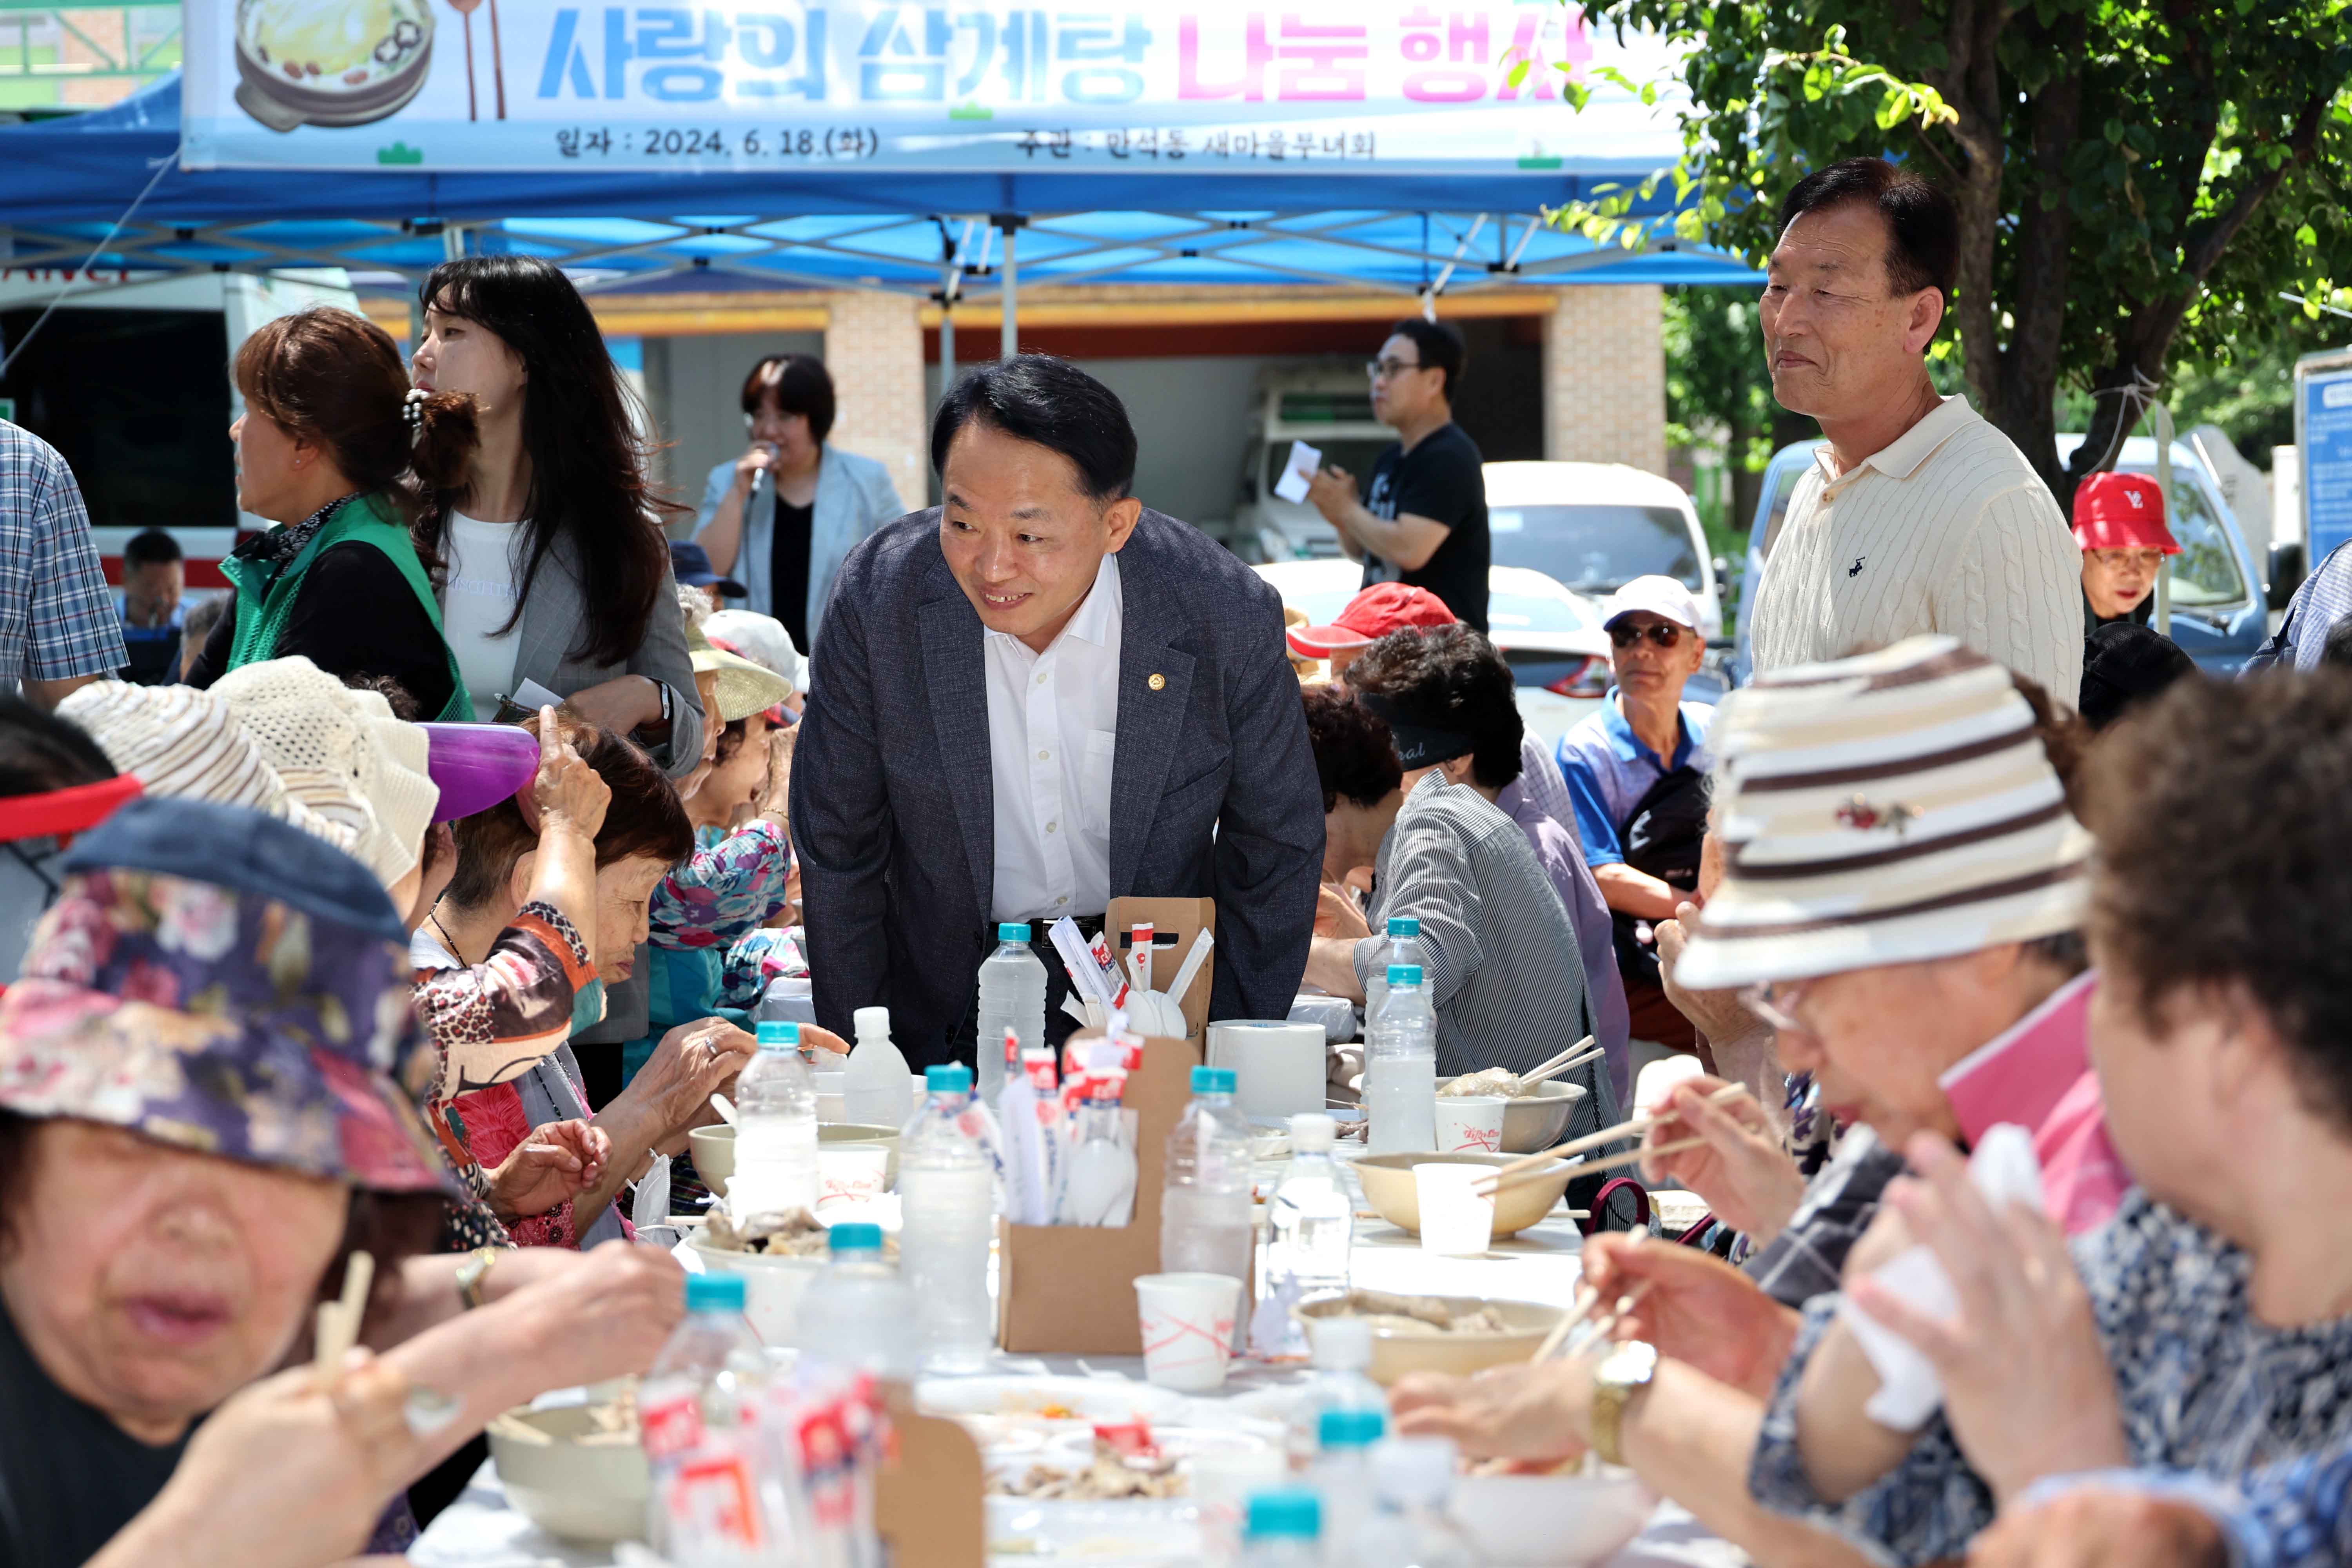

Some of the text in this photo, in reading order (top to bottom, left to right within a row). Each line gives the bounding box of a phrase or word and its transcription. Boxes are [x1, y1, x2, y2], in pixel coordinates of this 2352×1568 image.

[537, 8, 826, 102] 사랑의
[1178, 11, 1368, 102] 나눔
[1399, 5, 1593, 103] 행사
[556, 127, 612, 158] 일자
[644, 129, 732, 156] 2024.
[743, 129, 769, 156] 6.
[1016, 129, 1071, 158] 주관
[1107, 128, 1190, 159] 만석동
[1203, 129, 1375, 160] 새마을부녀회
